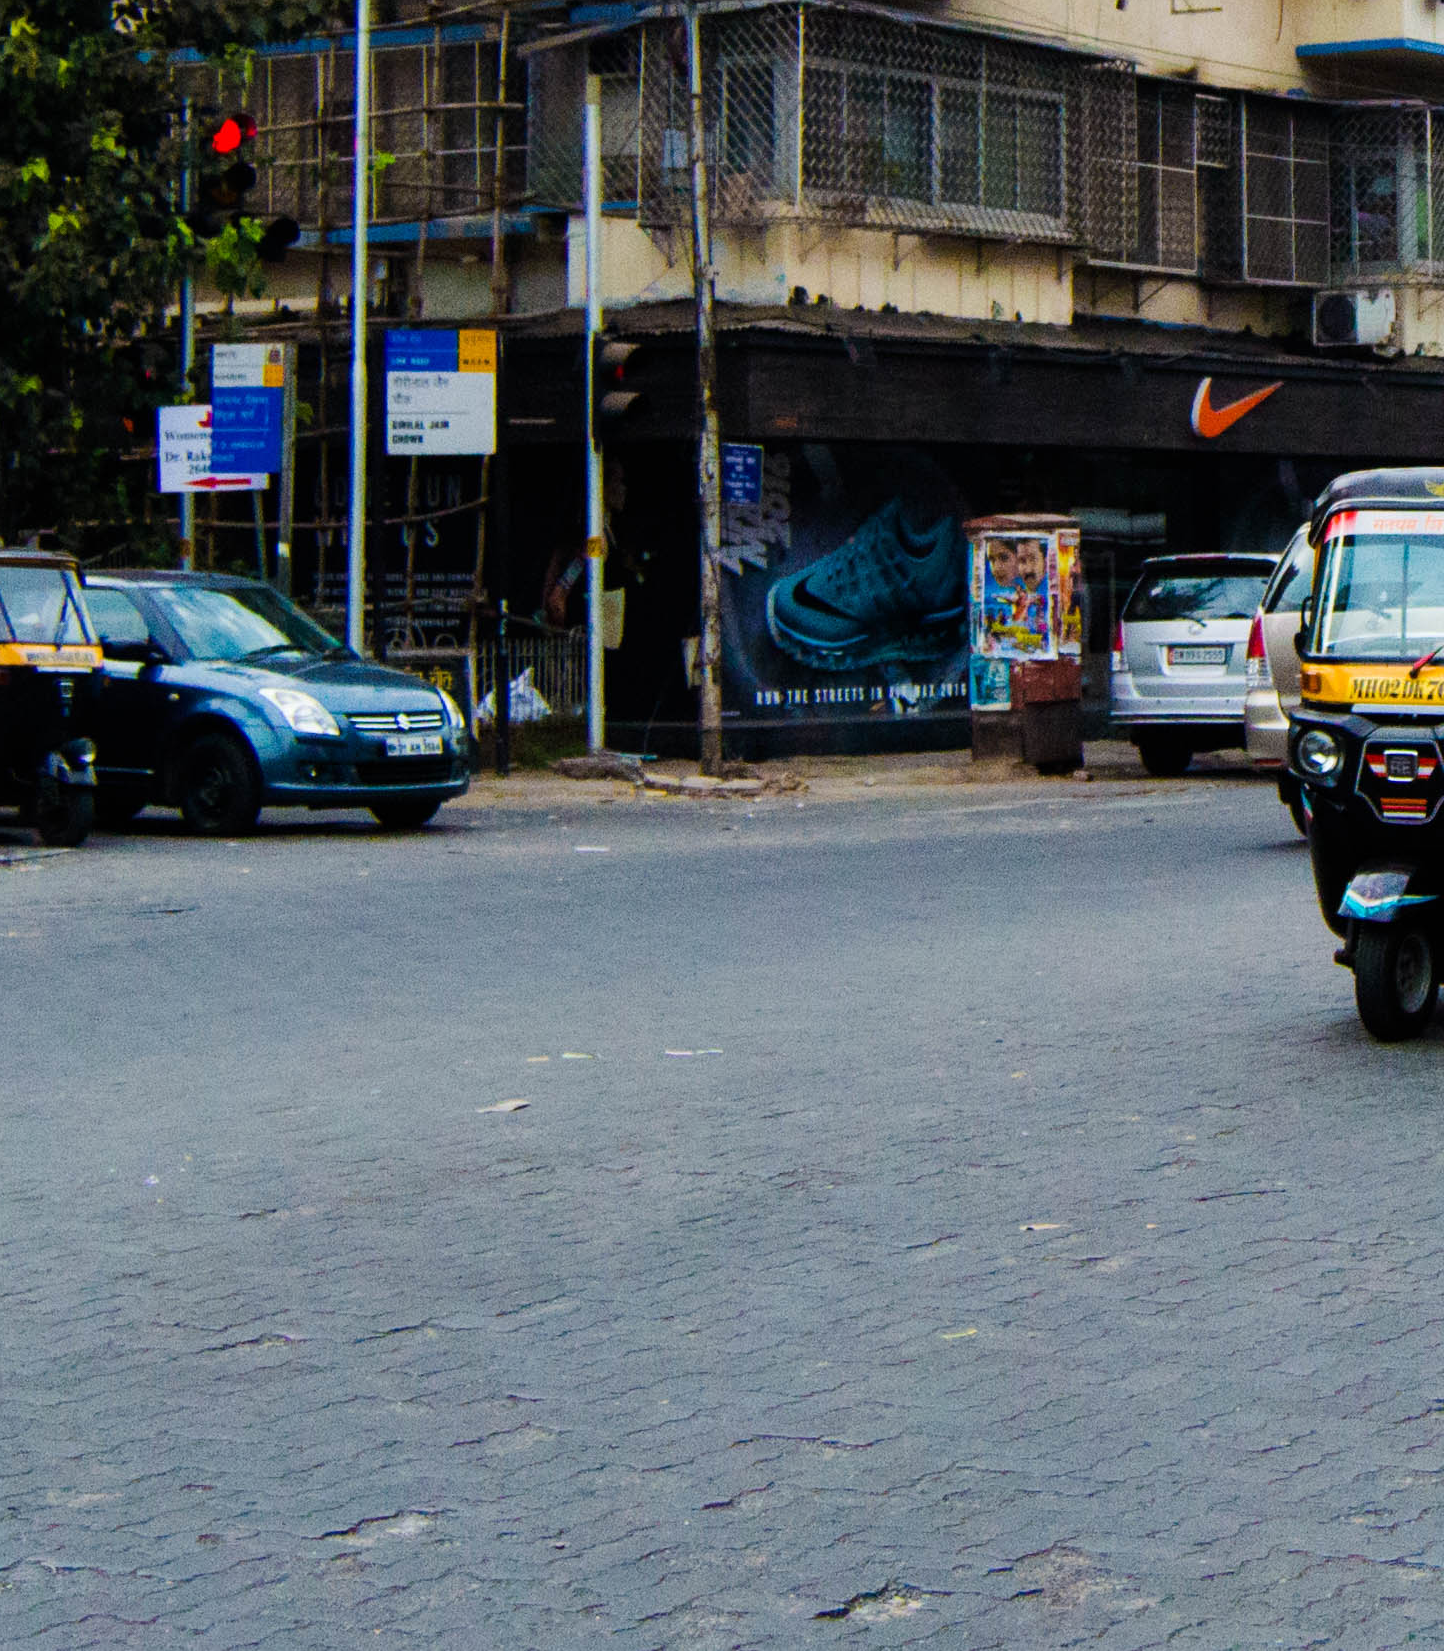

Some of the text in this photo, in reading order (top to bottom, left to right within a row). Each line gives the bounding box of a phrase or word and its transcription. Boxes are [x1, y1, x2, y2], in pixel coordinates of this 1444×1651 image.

[164, 451, 183, 463] Dr.
[755, 690, 782, 707] RUN
[786, 688, 809, 705] THE
[814, 685, 866, 704] STREETS
